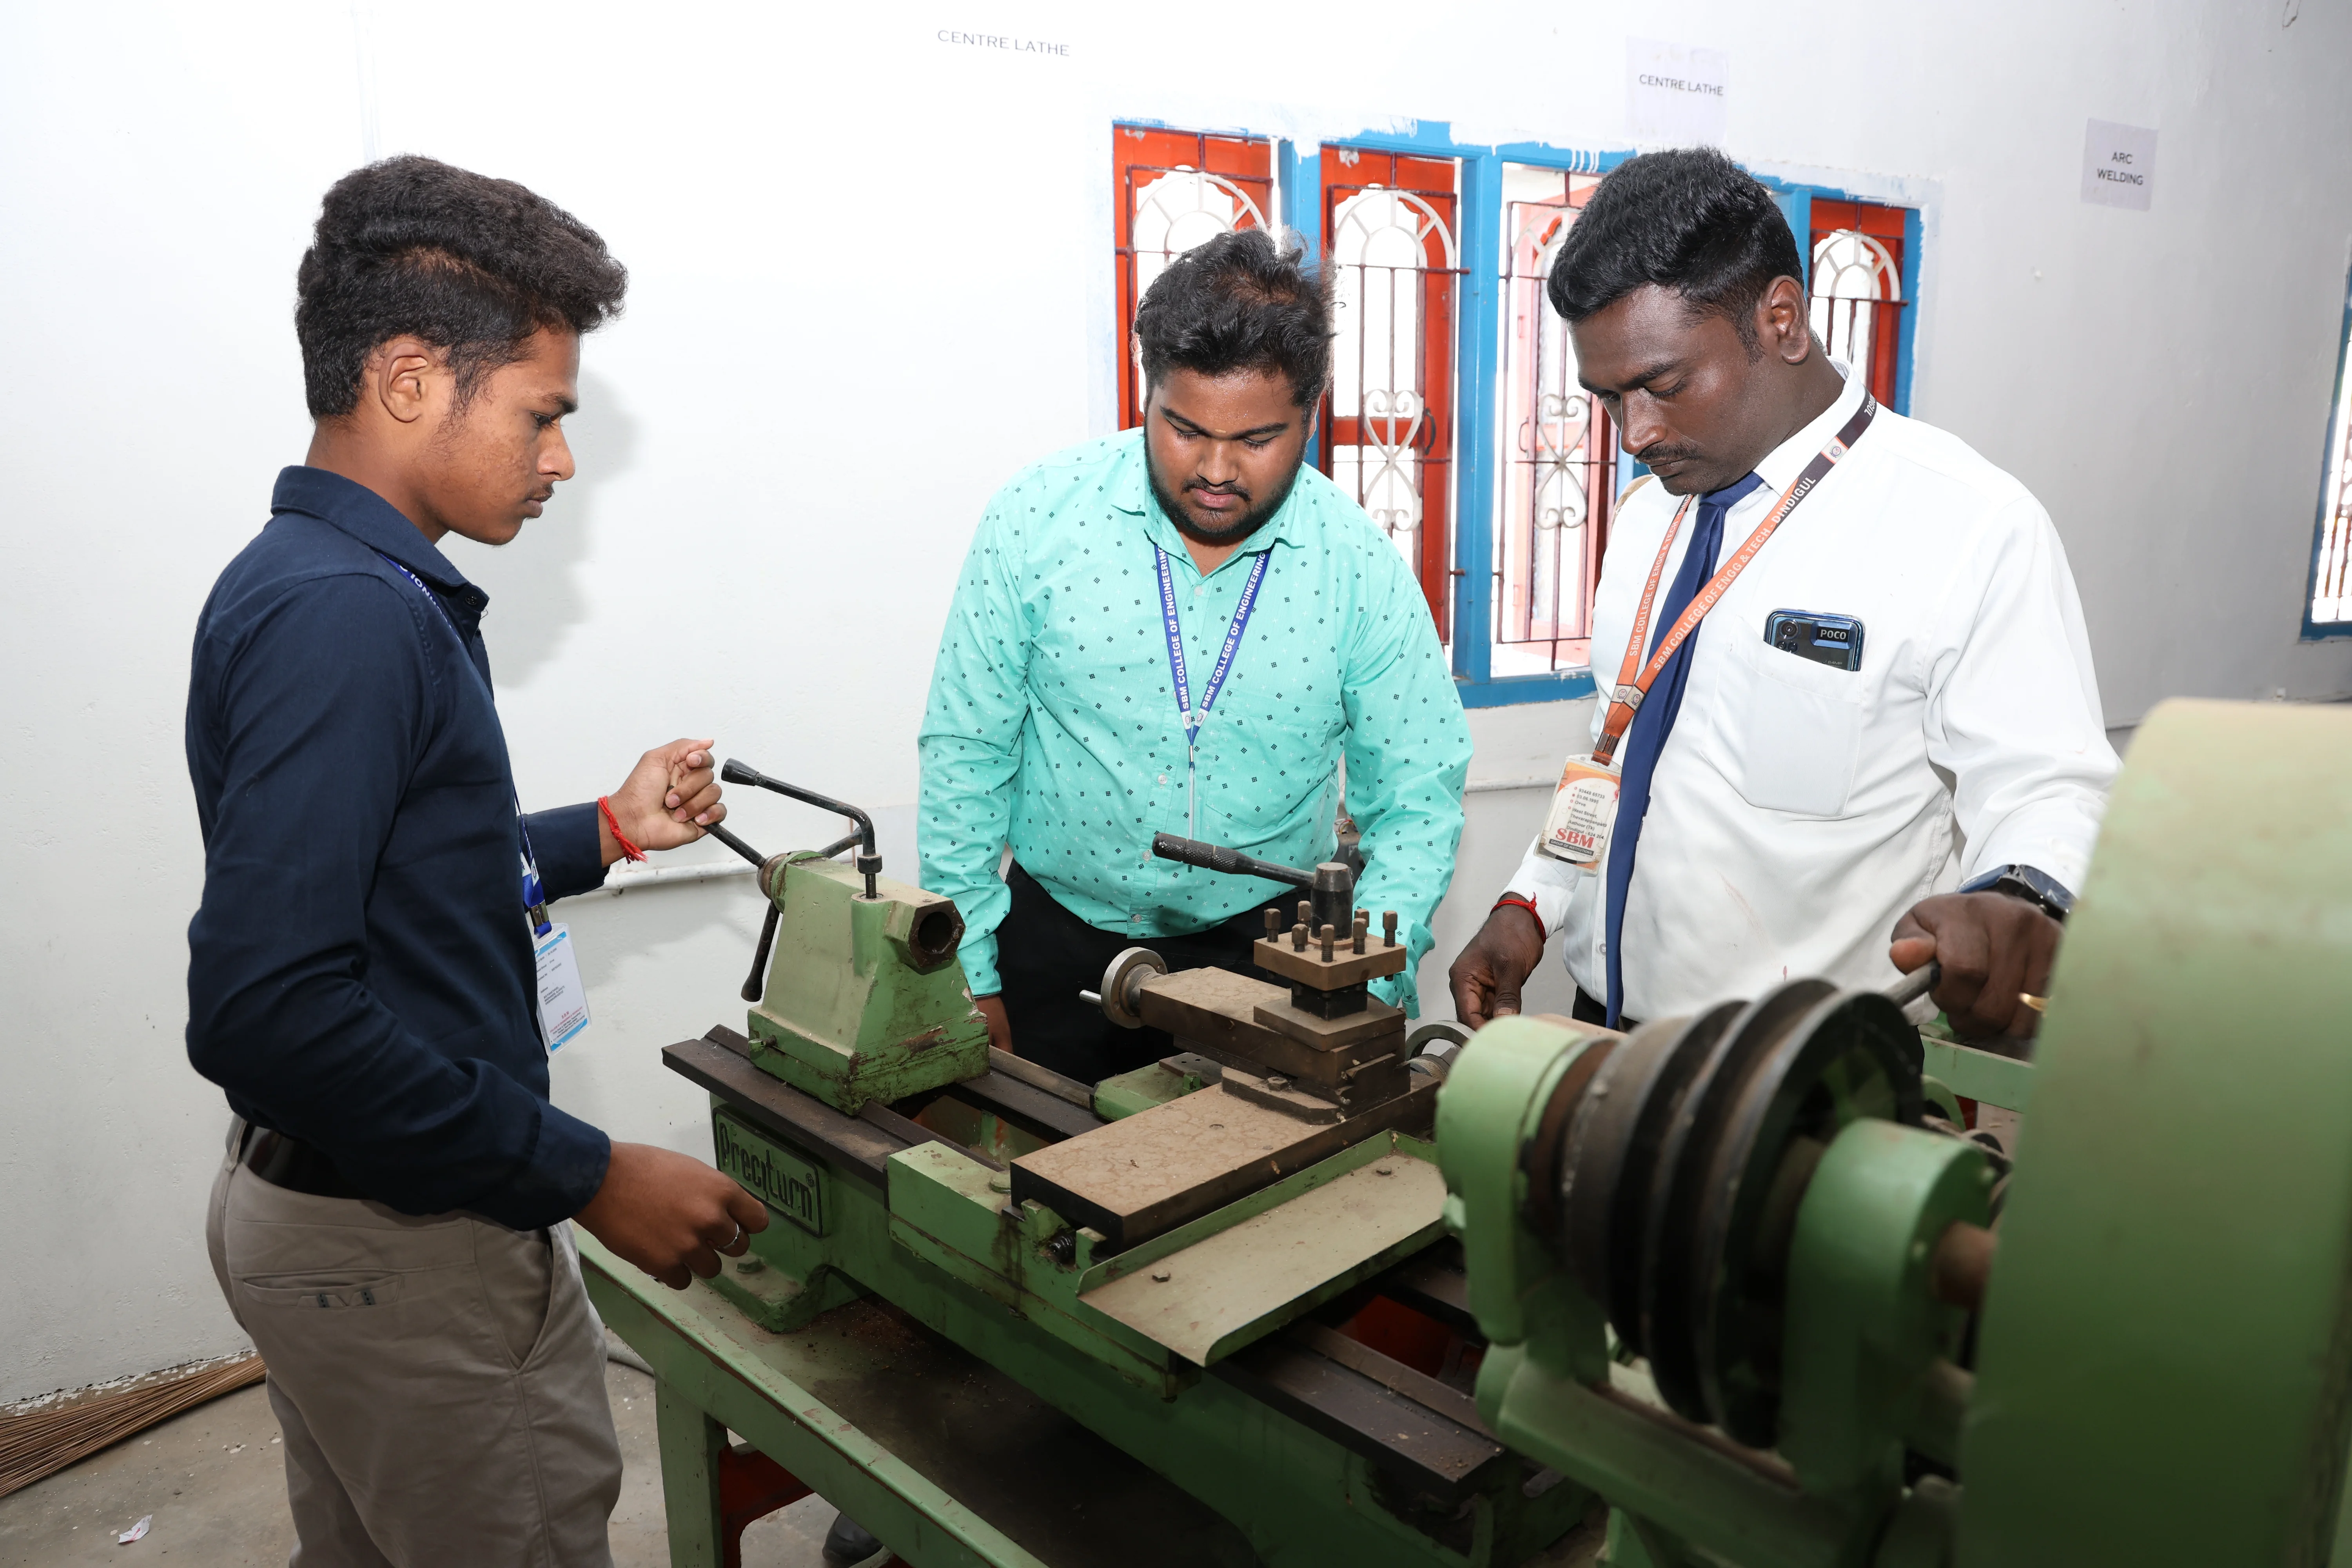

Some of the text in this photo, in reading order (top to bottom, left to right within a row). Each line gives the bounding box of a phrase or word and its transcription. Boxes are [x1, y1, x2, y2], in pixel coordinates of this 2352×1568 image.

[938, 30, 1069, 56] CENTRE LATHE
[1639, 74, 1724, 96] CENTRE LATHE
[2111, 151, 2133, 164] ARC
[2097, 168, 2143, 185] WELDING
[1664, 521, 1679, 544] TECH
[1651, 552, 1665, 577] ENGG
[1653, 646, 1673, 671] SBM
[1670, 601, 1708, 647] COLLEGE
[1704, 588, 1719, 604] OF
[1715, 562, 1743, 592] ENGG
[1739, 554, 1750, 563] &
[1745, 527, 1771, 554] TECH
[1771, 477, 1816, 524] DINDIGUL
[1648, 579, 1657, 590] OF
[1635, 592, 1653, 633] COLLEGE
[1169, 619, 1178, 633] OF
[1202, 552, 1265, 708] SBM COLLEGE OF ENGINEERING
[1820, 629, 1846, 640] POCO
[1629, 635, 1642, 657] SBM
[1171, 635, 1186, 684] COLLEGE
[1179, 686, 1189, 709] SBM
[1555, 828, 1594, 848] SBM
[1569, 845, 1592, 855] INSTITUTIONS
[719, 1122, 813, 1222] Preciturn
